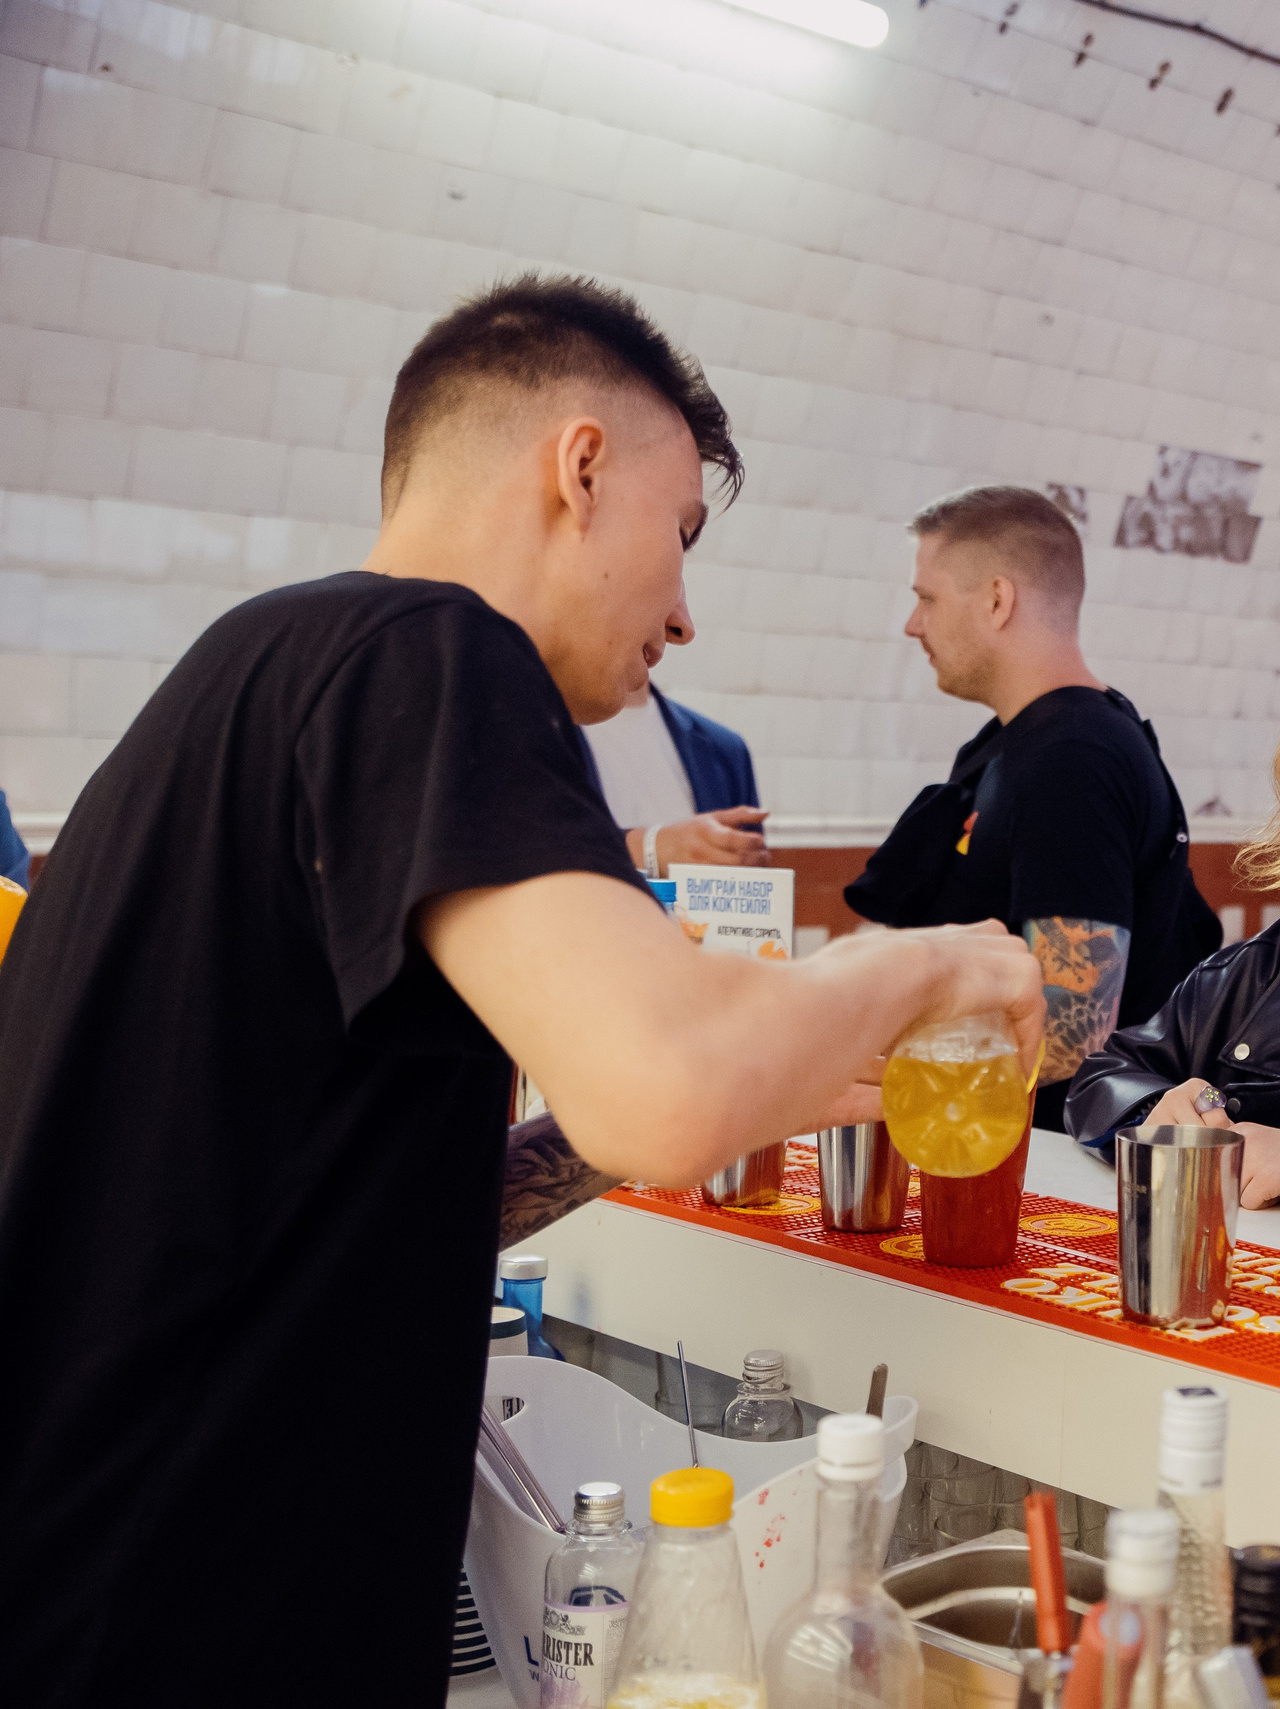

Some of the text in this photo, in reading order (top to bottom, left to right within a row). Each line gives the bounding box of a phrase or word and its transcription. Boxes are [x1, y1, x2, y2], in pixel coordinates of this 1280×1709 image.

[686, 877, 773, 898] ВЫИГРАЙ НАБОР
[688, 895, 711, 912] ДЛЯ
